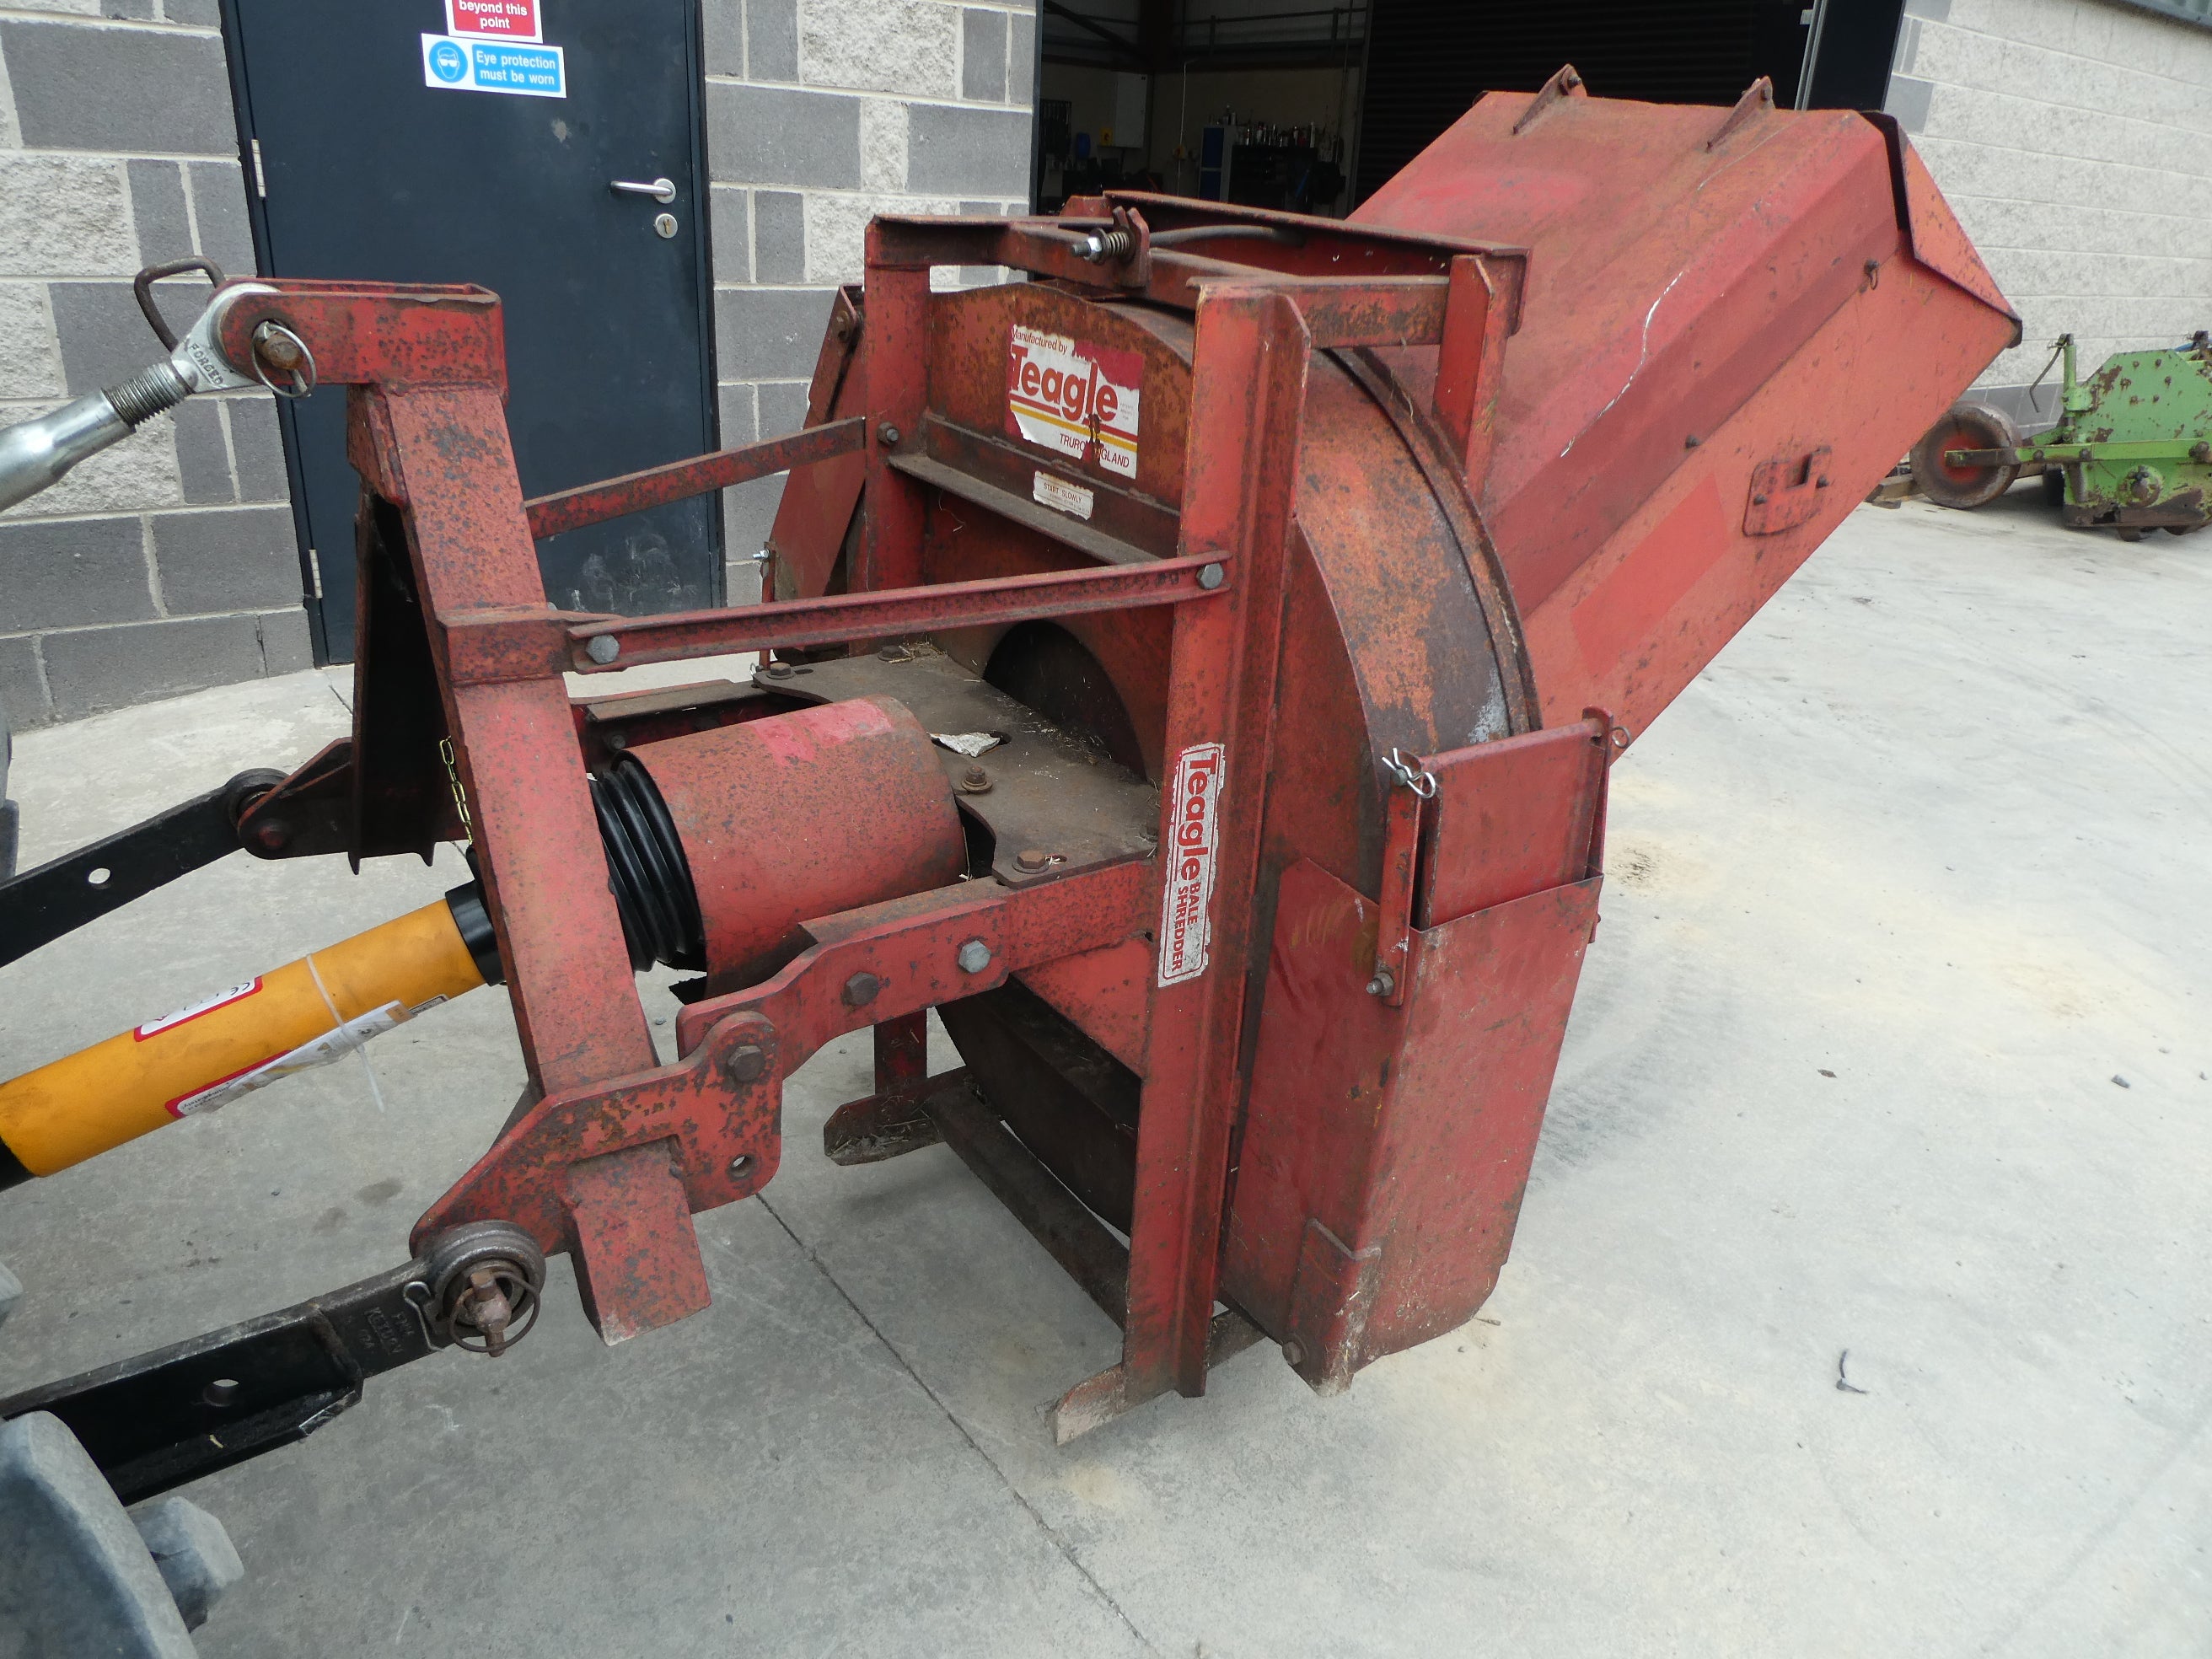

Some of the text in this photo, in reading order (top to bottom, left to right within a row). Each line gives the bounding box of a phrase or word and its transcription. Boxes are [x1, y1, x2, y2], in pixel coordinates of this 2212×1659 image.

[459, 0, 527, 15] beyond this
[480, 17, 510, 29] point
[476, 51, 556, 69] Eye protection
[481, 70, 555, 85] must be worn
[1059, 341, 1067, 355] by
[190, 343, 223, 385] FORGED
[1012, 344, 1119, 421] Teagle
[1096, 447, 1130, 468] GLAND
[1044, 482, 1060, 495] START
[1062, 489, 1082, 504] SLOWLY
[1178, 753, 1217, 882] Teagle
[1188, 883, 1200, 925] BALE
[1172, 887, 1189, 971] SHREDDER
